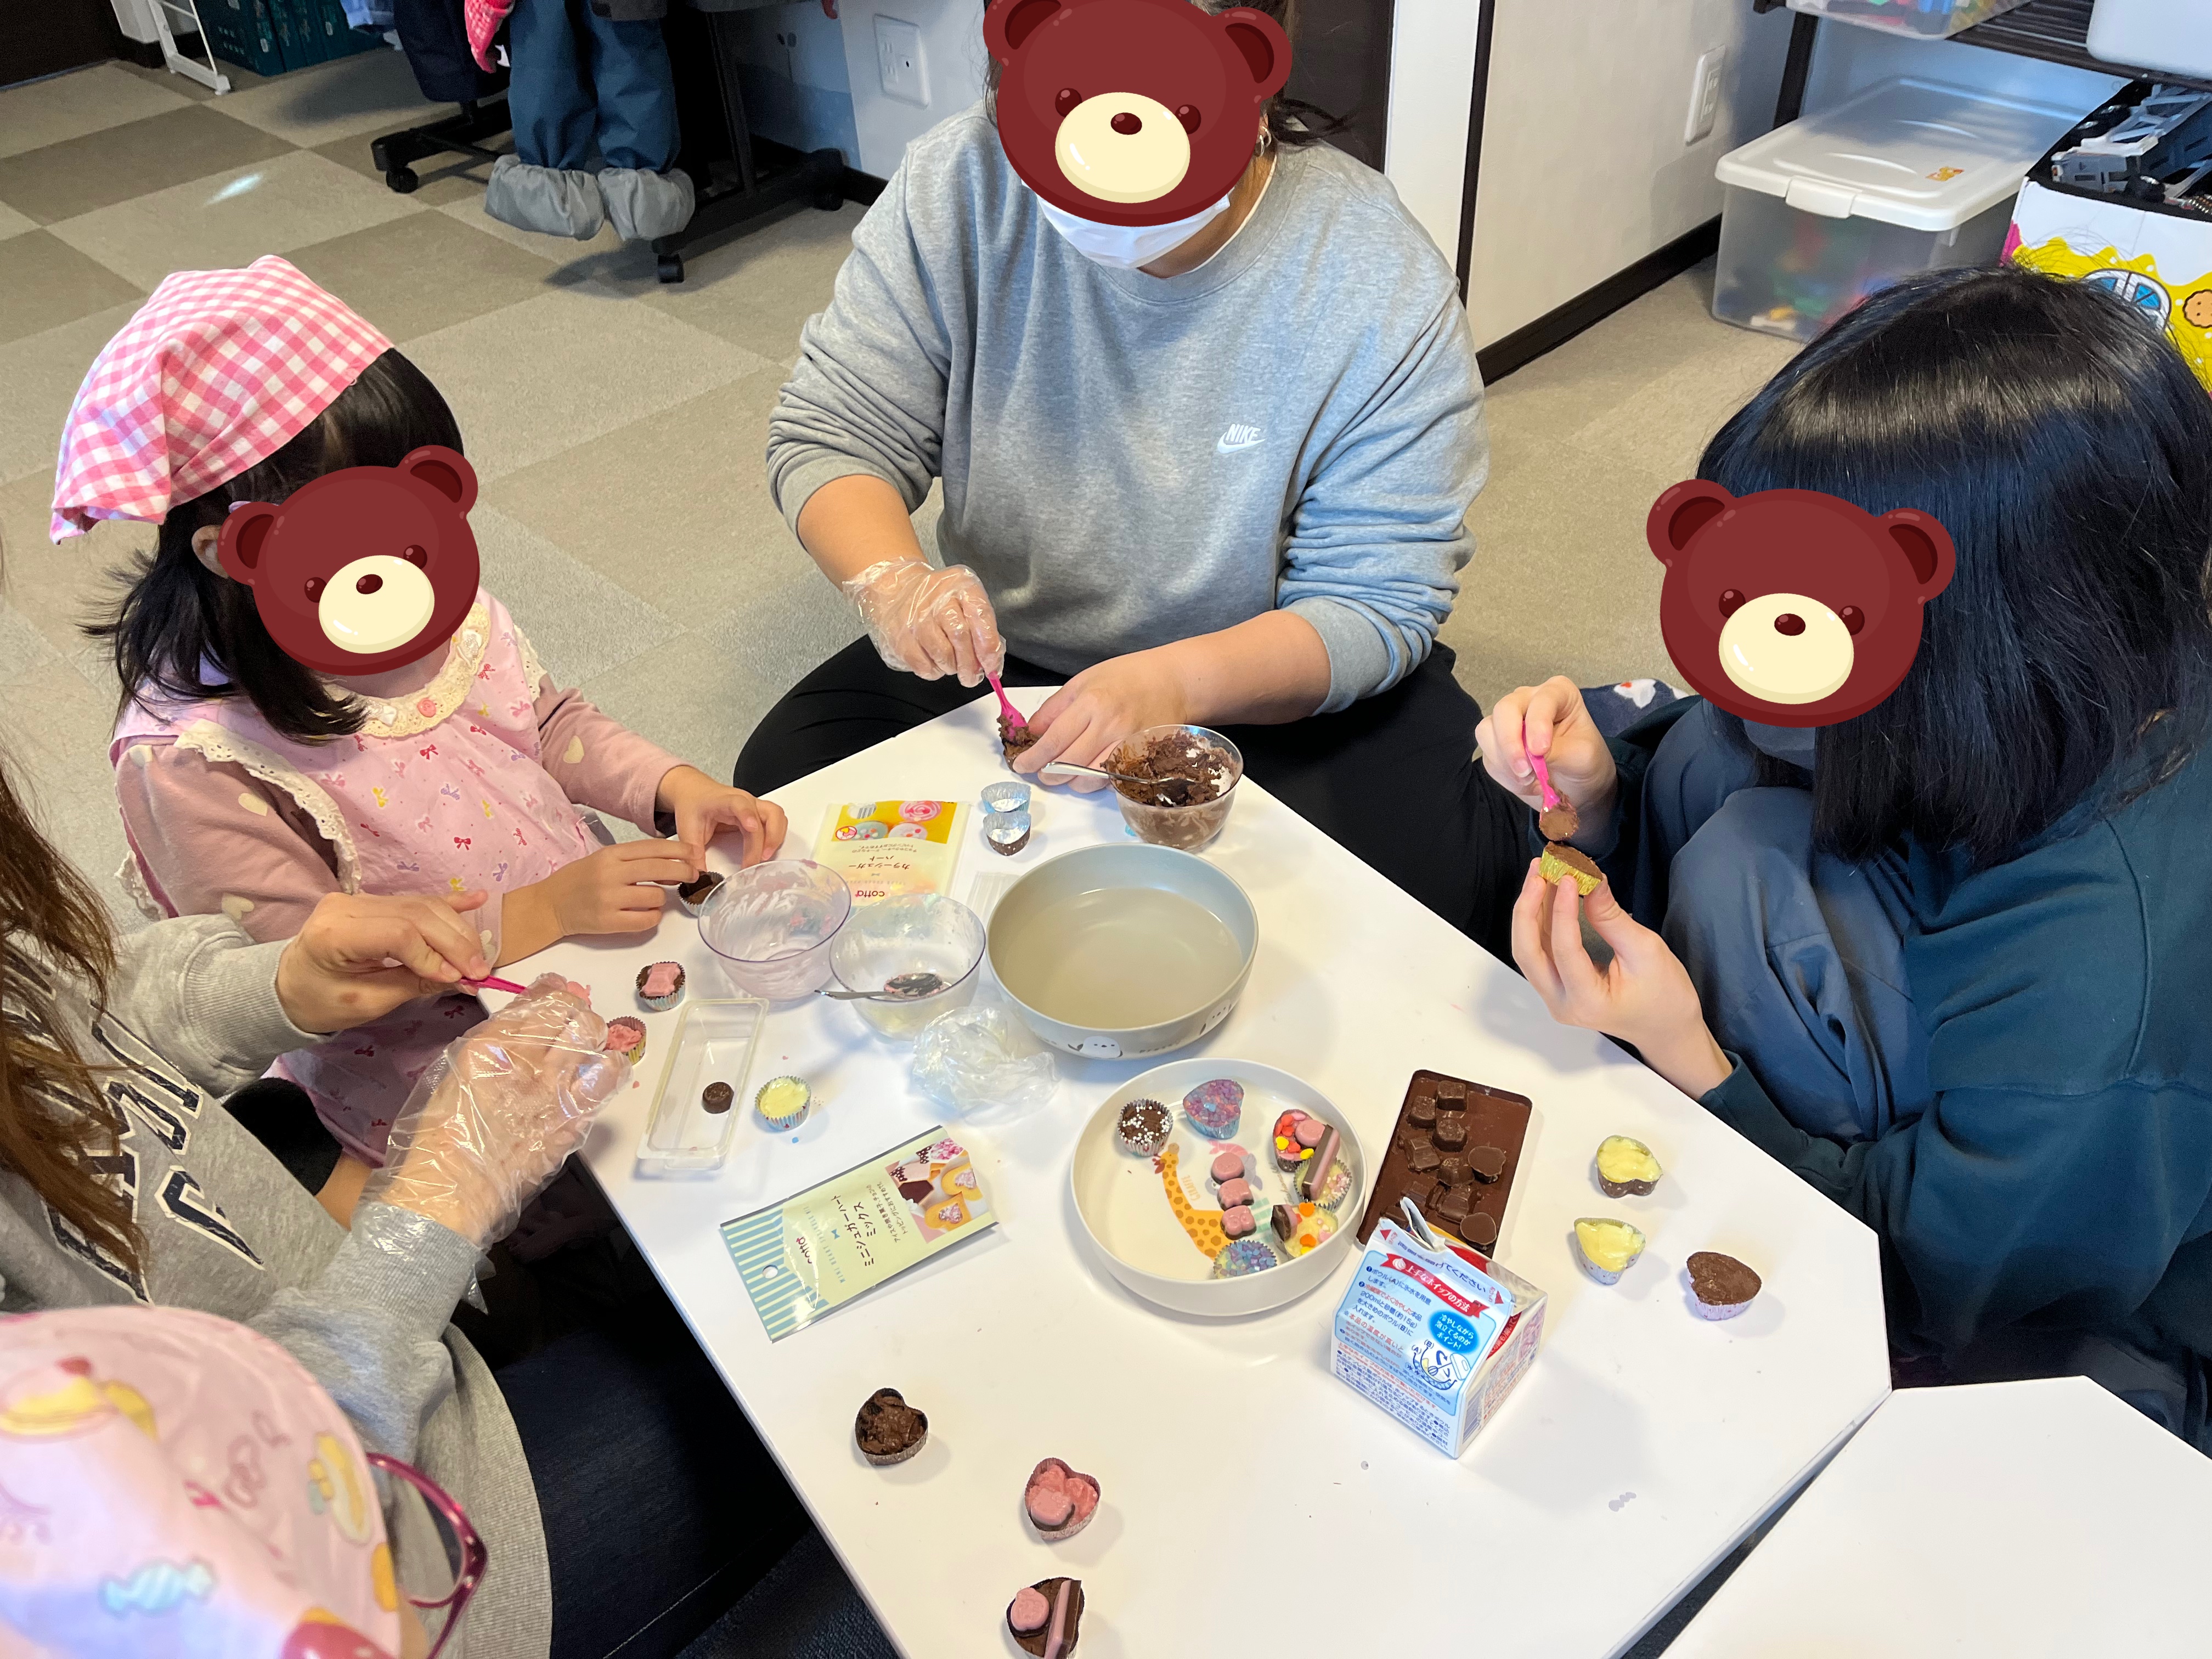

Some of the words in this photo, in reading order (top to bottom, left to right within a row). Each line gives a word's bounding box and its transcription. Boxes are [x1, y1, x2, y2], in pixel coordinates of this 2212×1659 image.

[1226, 424, 1261, 443] NIKE
[848, 862, 910, 870] カラーシュガー
[854, 889, 885, 898] cotta
[829, 1193, 876, 1268] ミニシュガーハート
[851, 1200, 877, 1238] ミックス
[1367, 1274, 1387, 1289] します。
[1404, 1264, 1471, 1313] 上手なホイップの方法
[1352, 1304, 1377, 1323] 入れます。
[1434, 1320, 1472, 1347] 泡立てるのが
[1439, 1313, 1476, 1340] 冷やしながら
